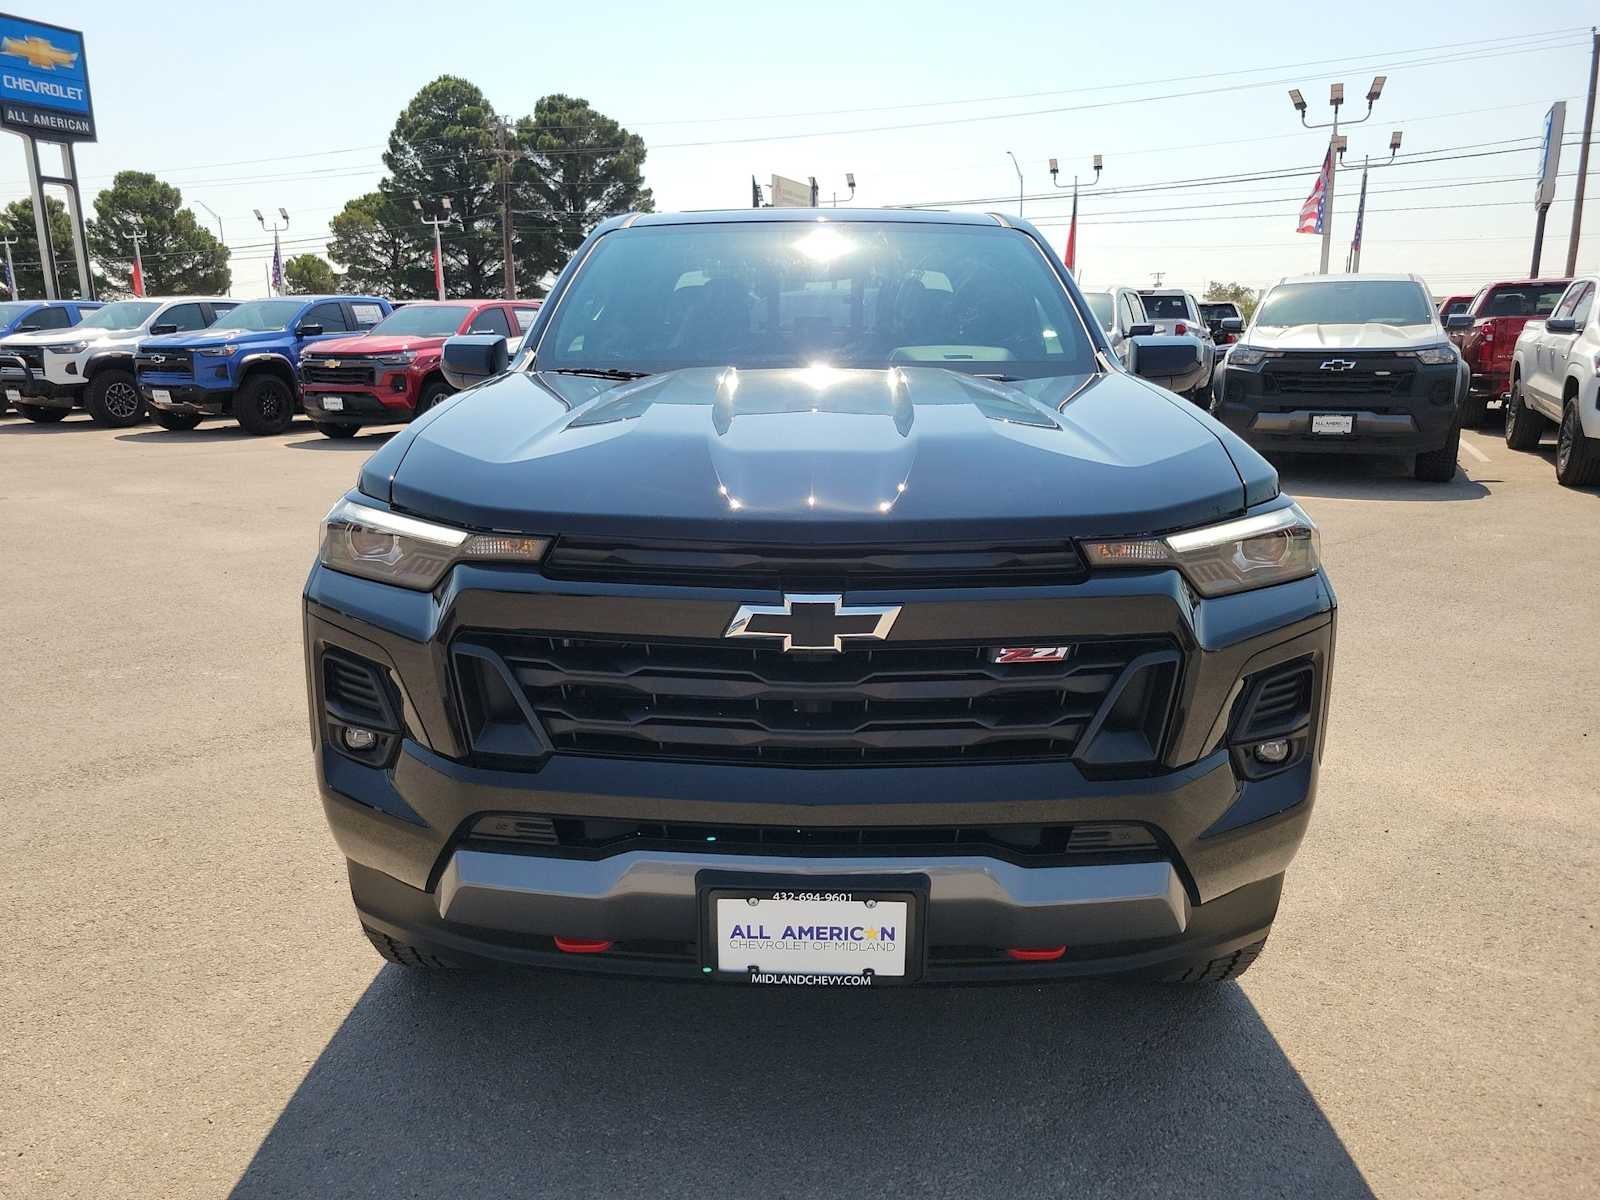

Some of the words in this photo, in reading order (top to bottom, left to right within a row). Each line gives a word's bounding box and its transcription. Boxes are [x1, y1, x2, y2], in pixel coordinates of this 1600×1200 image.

[3, 75, 83, 100] CHEVROLET
[8, 110, 28, 122] ALL
[34, 114, 90, 132] AMERICAN
[773, 892, 853, 902] 432-694-9601
[730, 925, 771, 940] ALL
[782, 926, 896, 941] AMERICN
[729, 940, 808, 950] CHEVROLET
[812, 942, 831, 951] OF
[834, 942, 896, 952] MIDLAND
[751, 974, 871, 986] MIDLANDCHEVY.COM
